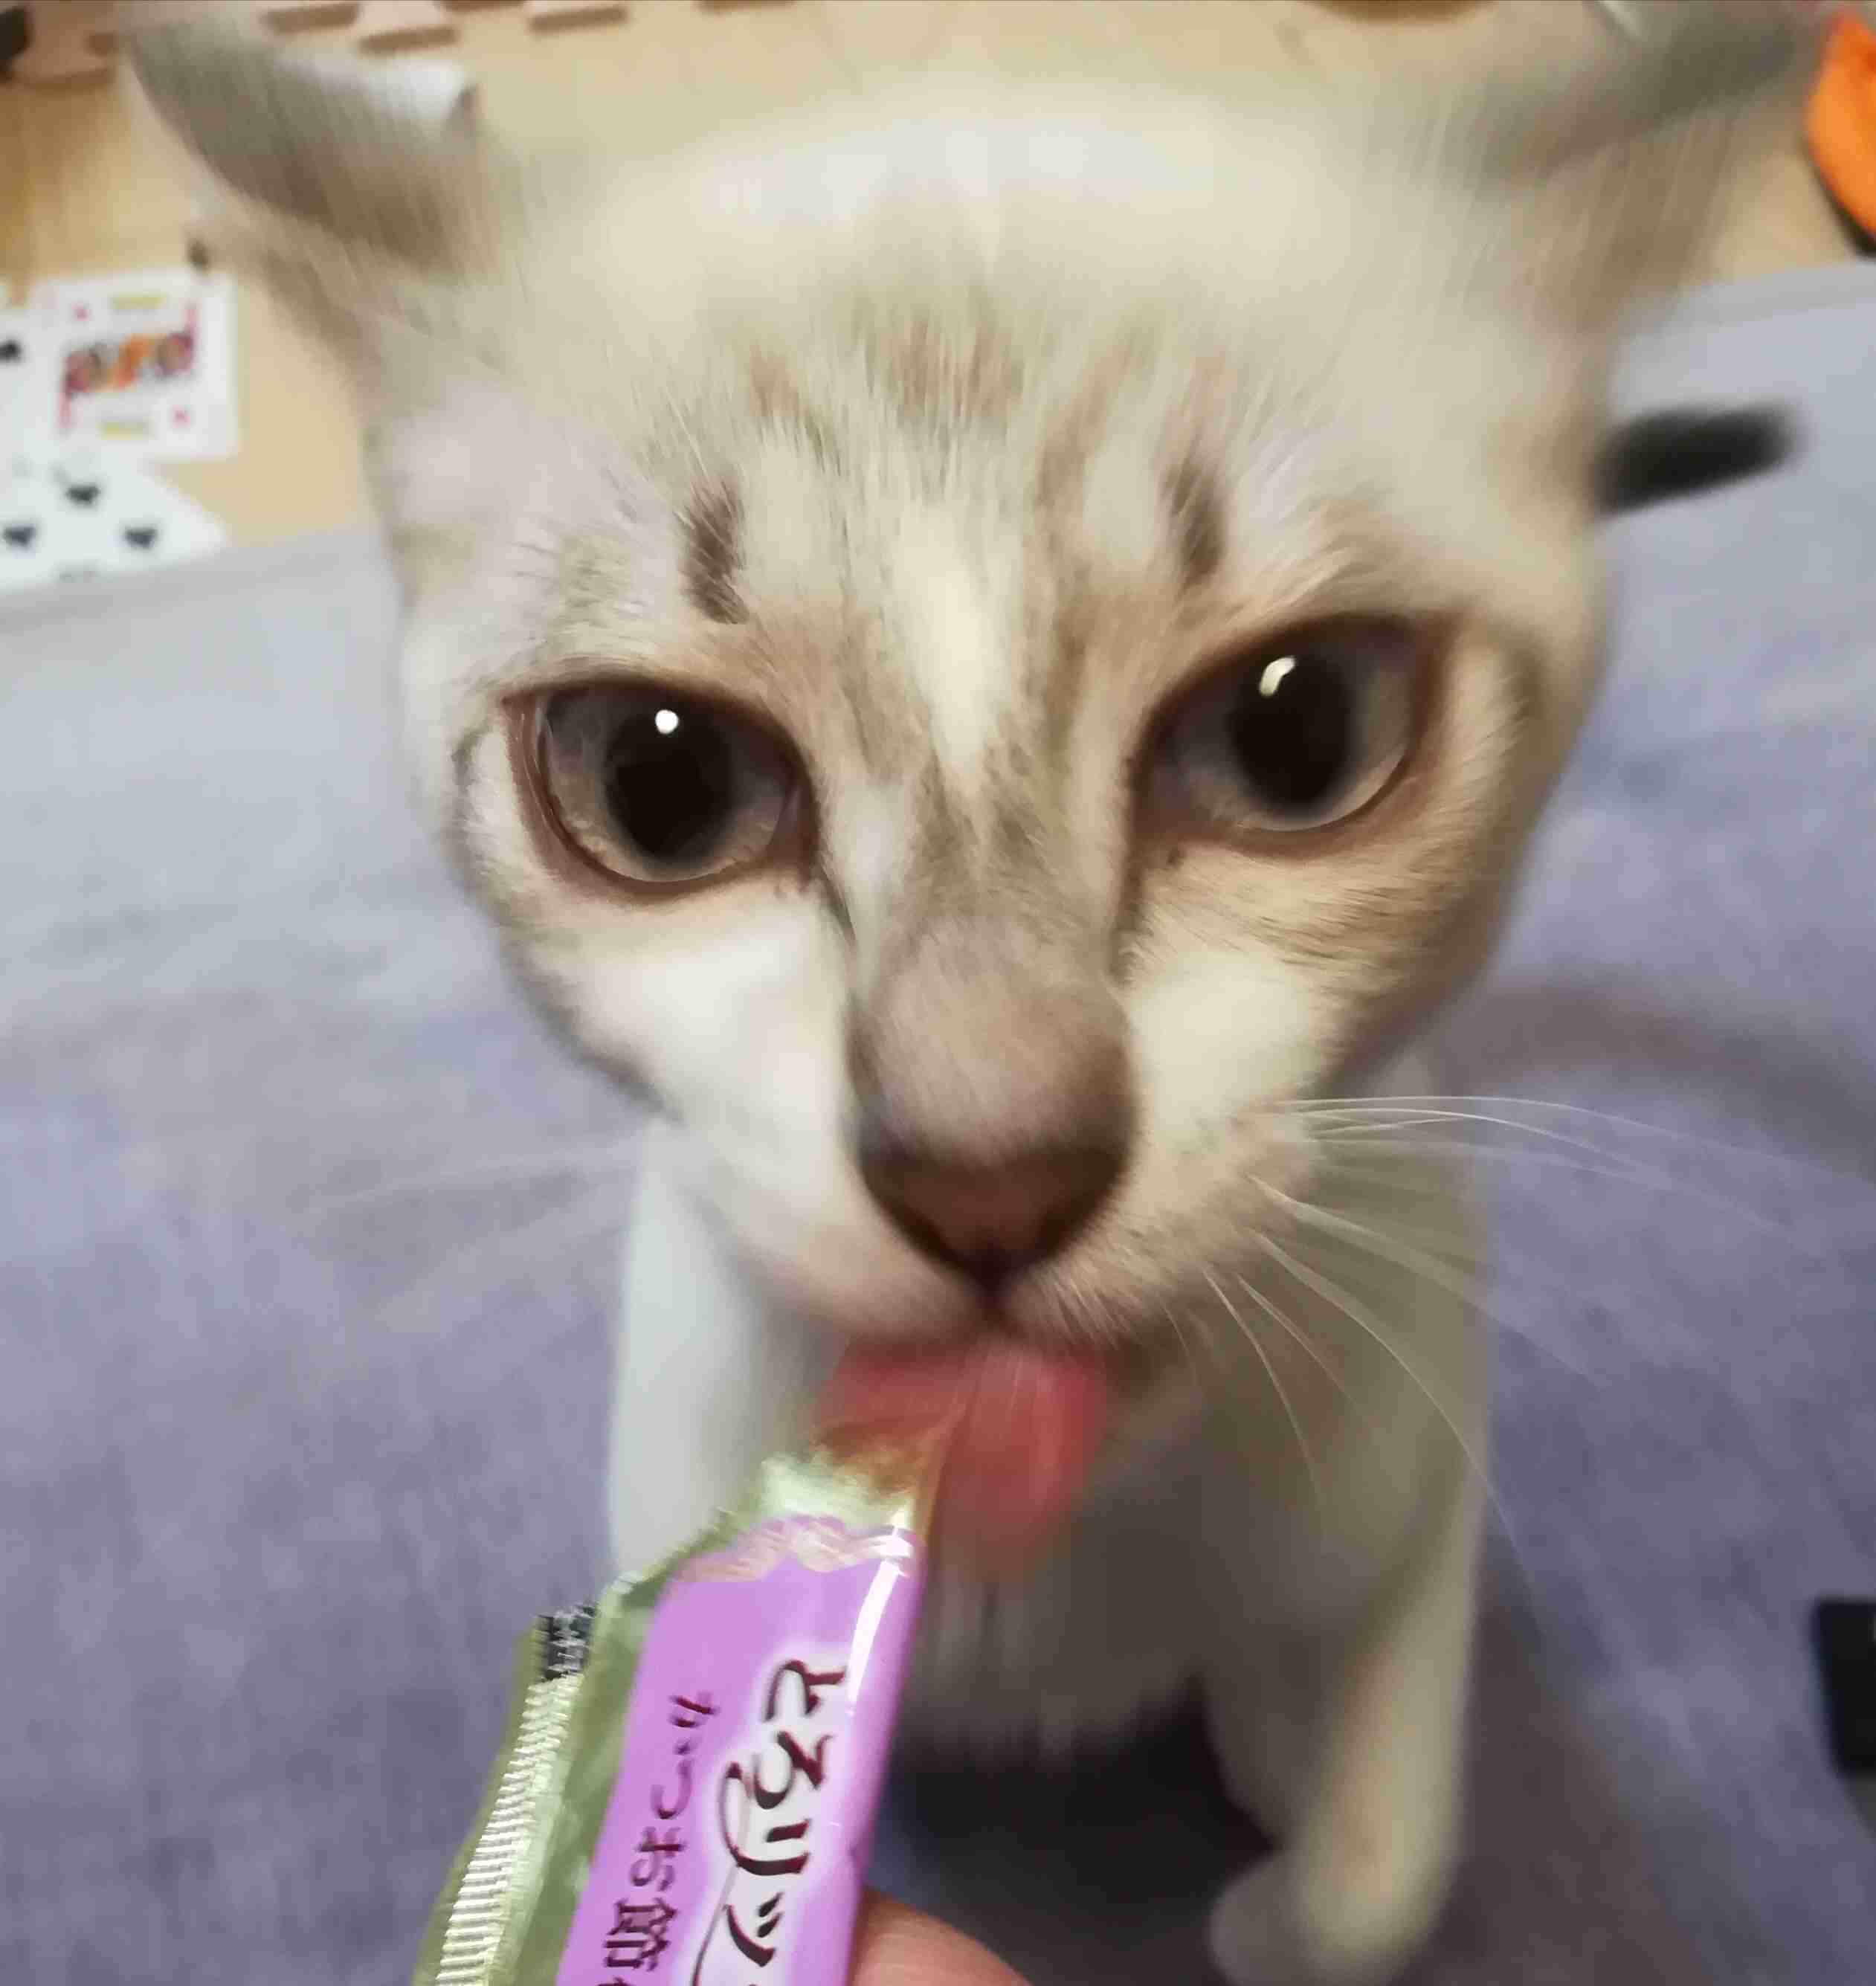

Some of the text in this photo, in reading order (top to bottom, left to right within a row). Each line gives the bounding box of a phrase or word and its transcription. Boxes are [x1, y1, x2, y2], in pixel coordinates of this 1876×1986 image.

[598, 1692, 717, 1986] かつお節
[706, 1659, 848, 1986] とろリッ
